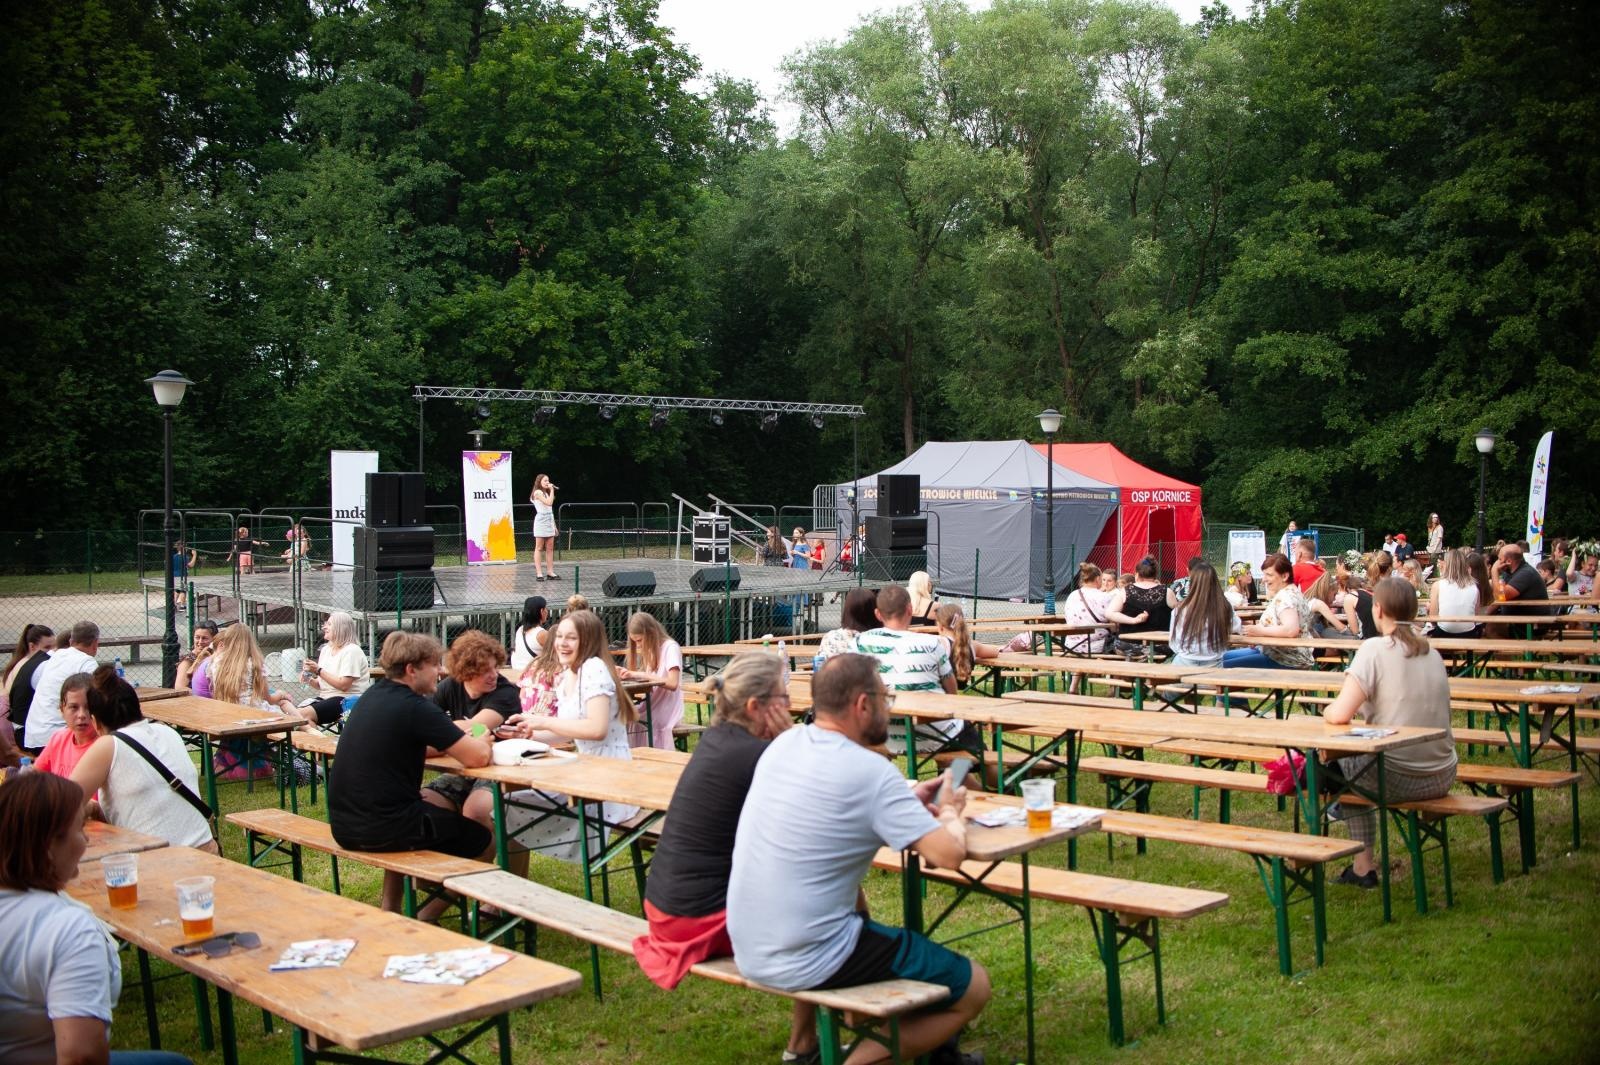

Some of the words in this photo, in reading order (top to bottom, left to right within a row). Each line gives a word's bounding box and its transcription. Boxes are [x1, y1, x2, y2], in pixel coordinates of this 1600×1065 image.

[473, 488, 497, 500] mdk
[1131, 490, 1150, 503] OSP
[1152, 490, 1191, 503] KORNICE
[335, 506, 366, 518] mdk
